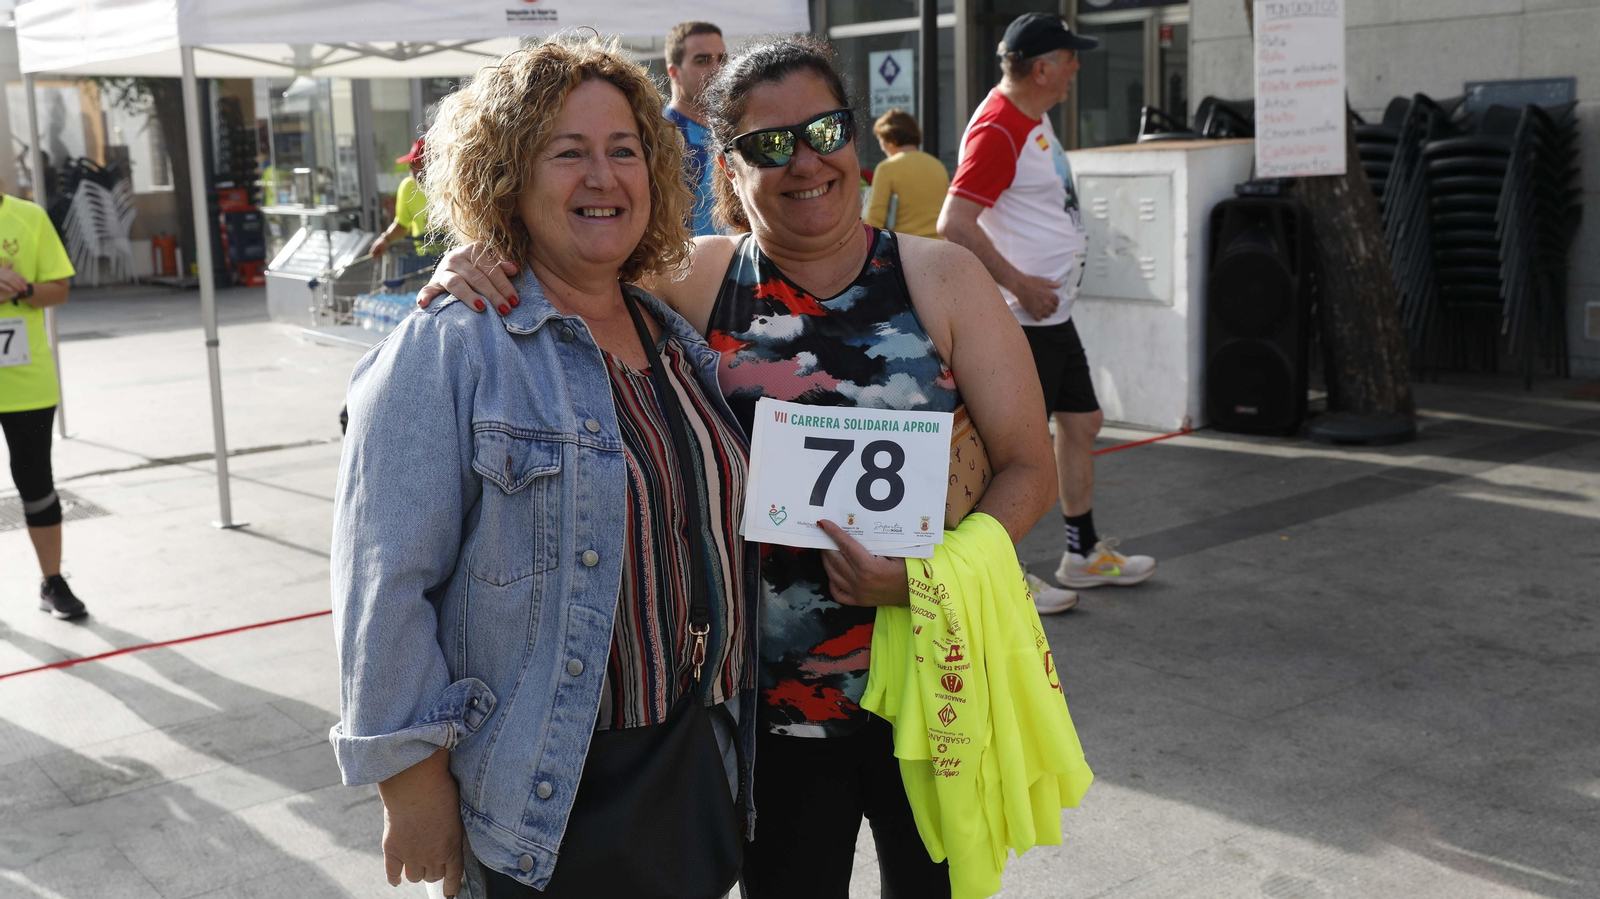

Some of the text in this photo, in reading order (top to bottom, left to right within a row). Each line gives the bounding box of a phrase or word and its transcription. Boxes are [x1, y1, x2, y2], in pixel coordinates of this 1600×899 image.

[0, 329, 15, 355] 7
[774, 411, 940, 433] VII CARRERA SOLIDARIA APRON
[804, 436, 905, 512] 78
[934, 692, 966, 704] PANADERIA
